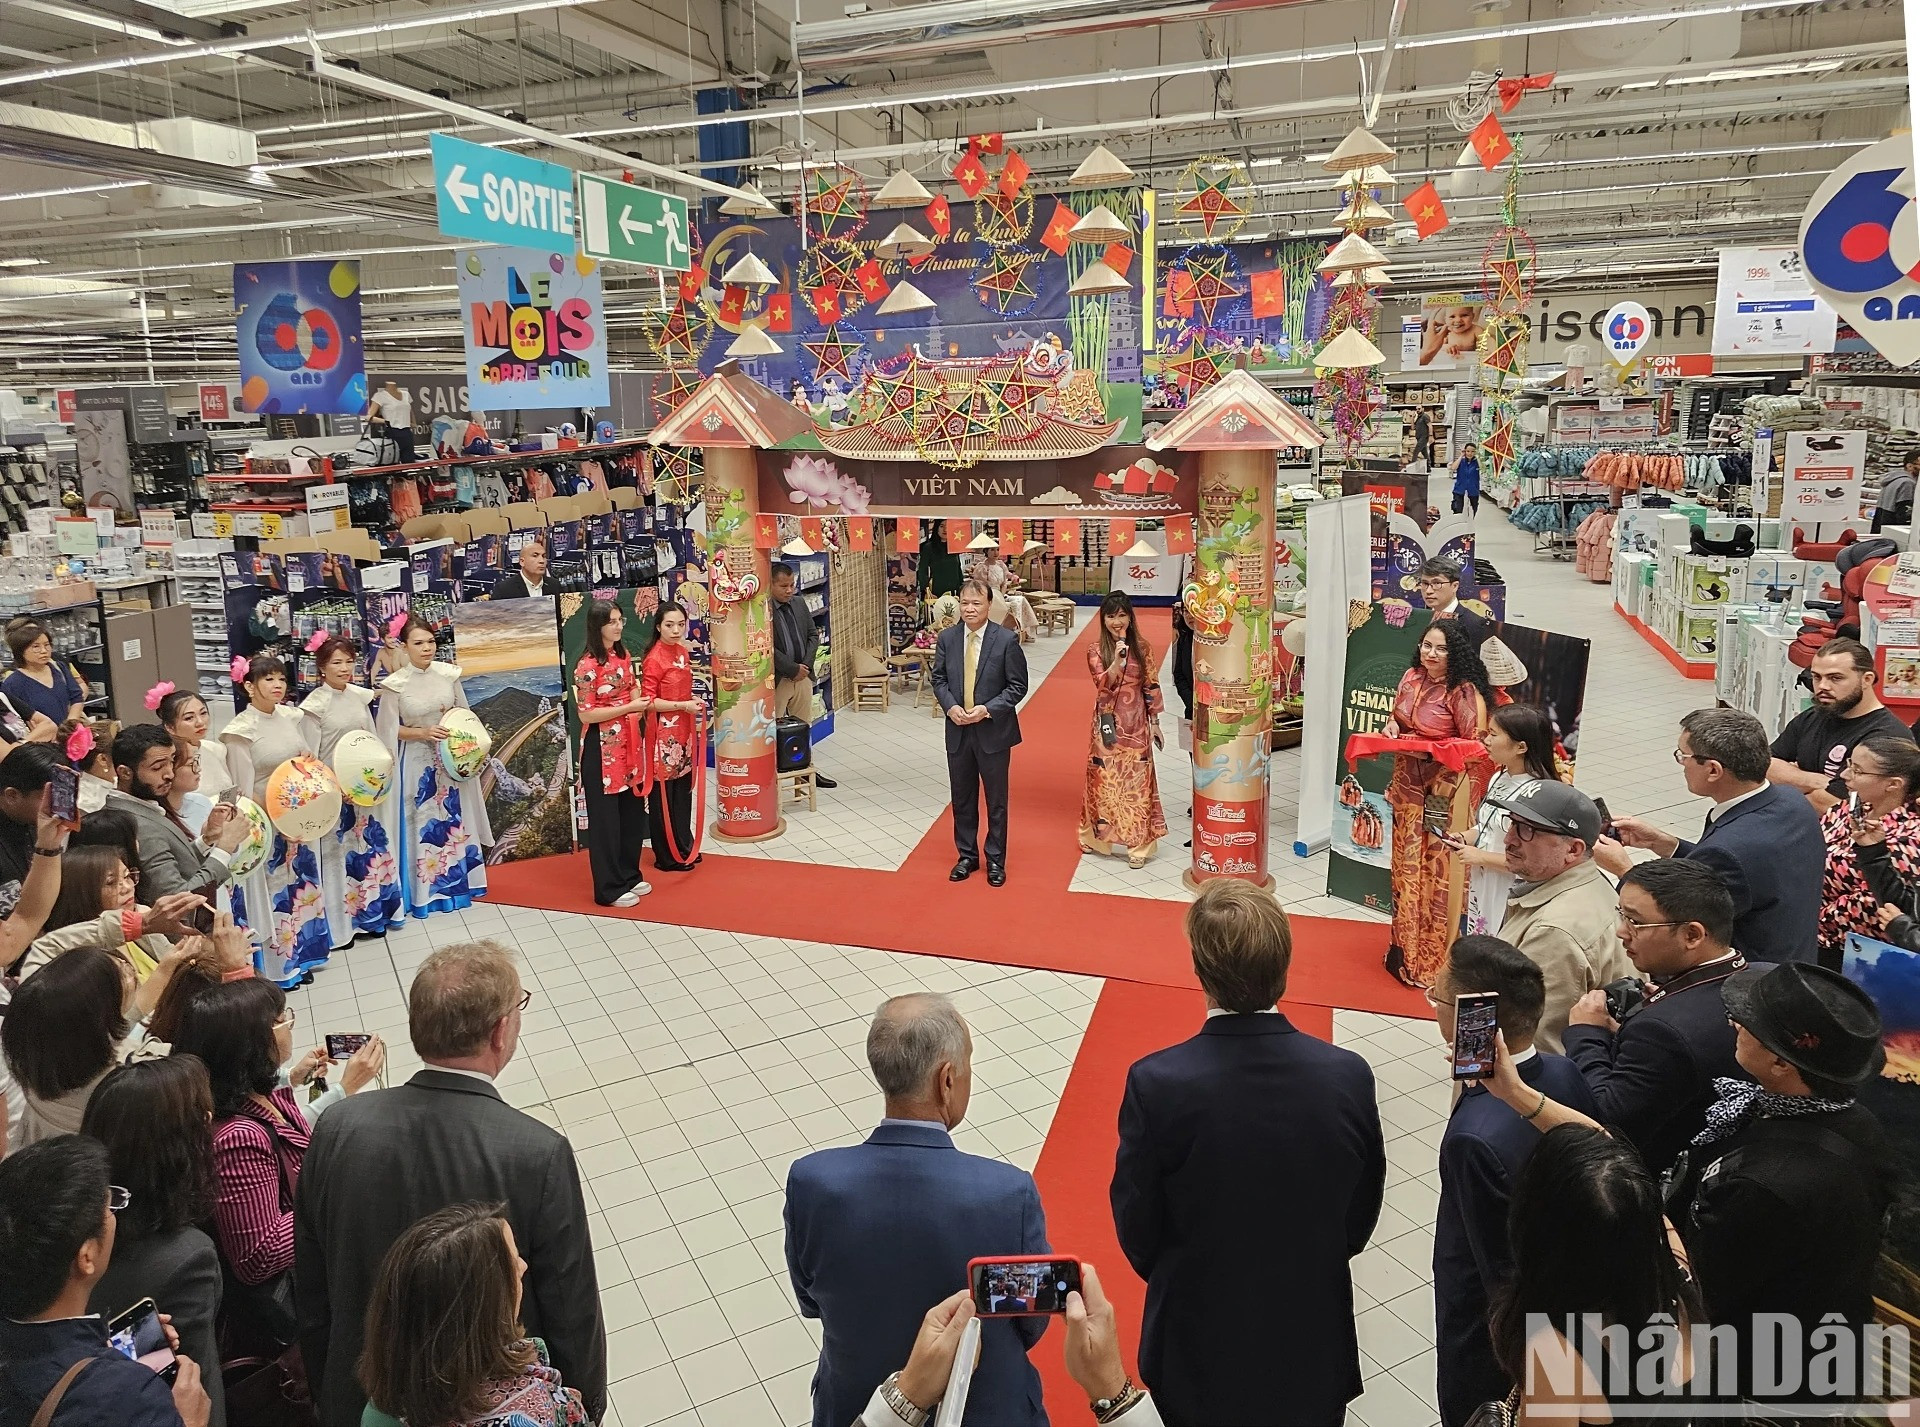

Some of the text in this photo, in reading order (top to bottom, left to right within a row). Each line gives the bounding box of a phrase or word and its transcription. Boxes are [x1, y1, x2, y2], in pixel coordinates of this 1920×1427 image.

[483, 172, 573, 235] SORTIE
[953, 227, 971, 243] la
[508, 267, 553, 308] LE
[1427, 295, 1462, 304] PARENTS
[256, 292, 341, 371] 60
[471, 298, 595, 360] MOIS
[1609, 313, 1644, 341] 60
[1614, 341, 1636, 349] ans
[290, 372, 322, 385] ans
[480, 361, 591, 384] CARREFOUR
[1645, 367, 1681, 376] LAN
[967, 478, 1025, 496] NAM
[381, 592, 408, 619] DIM
